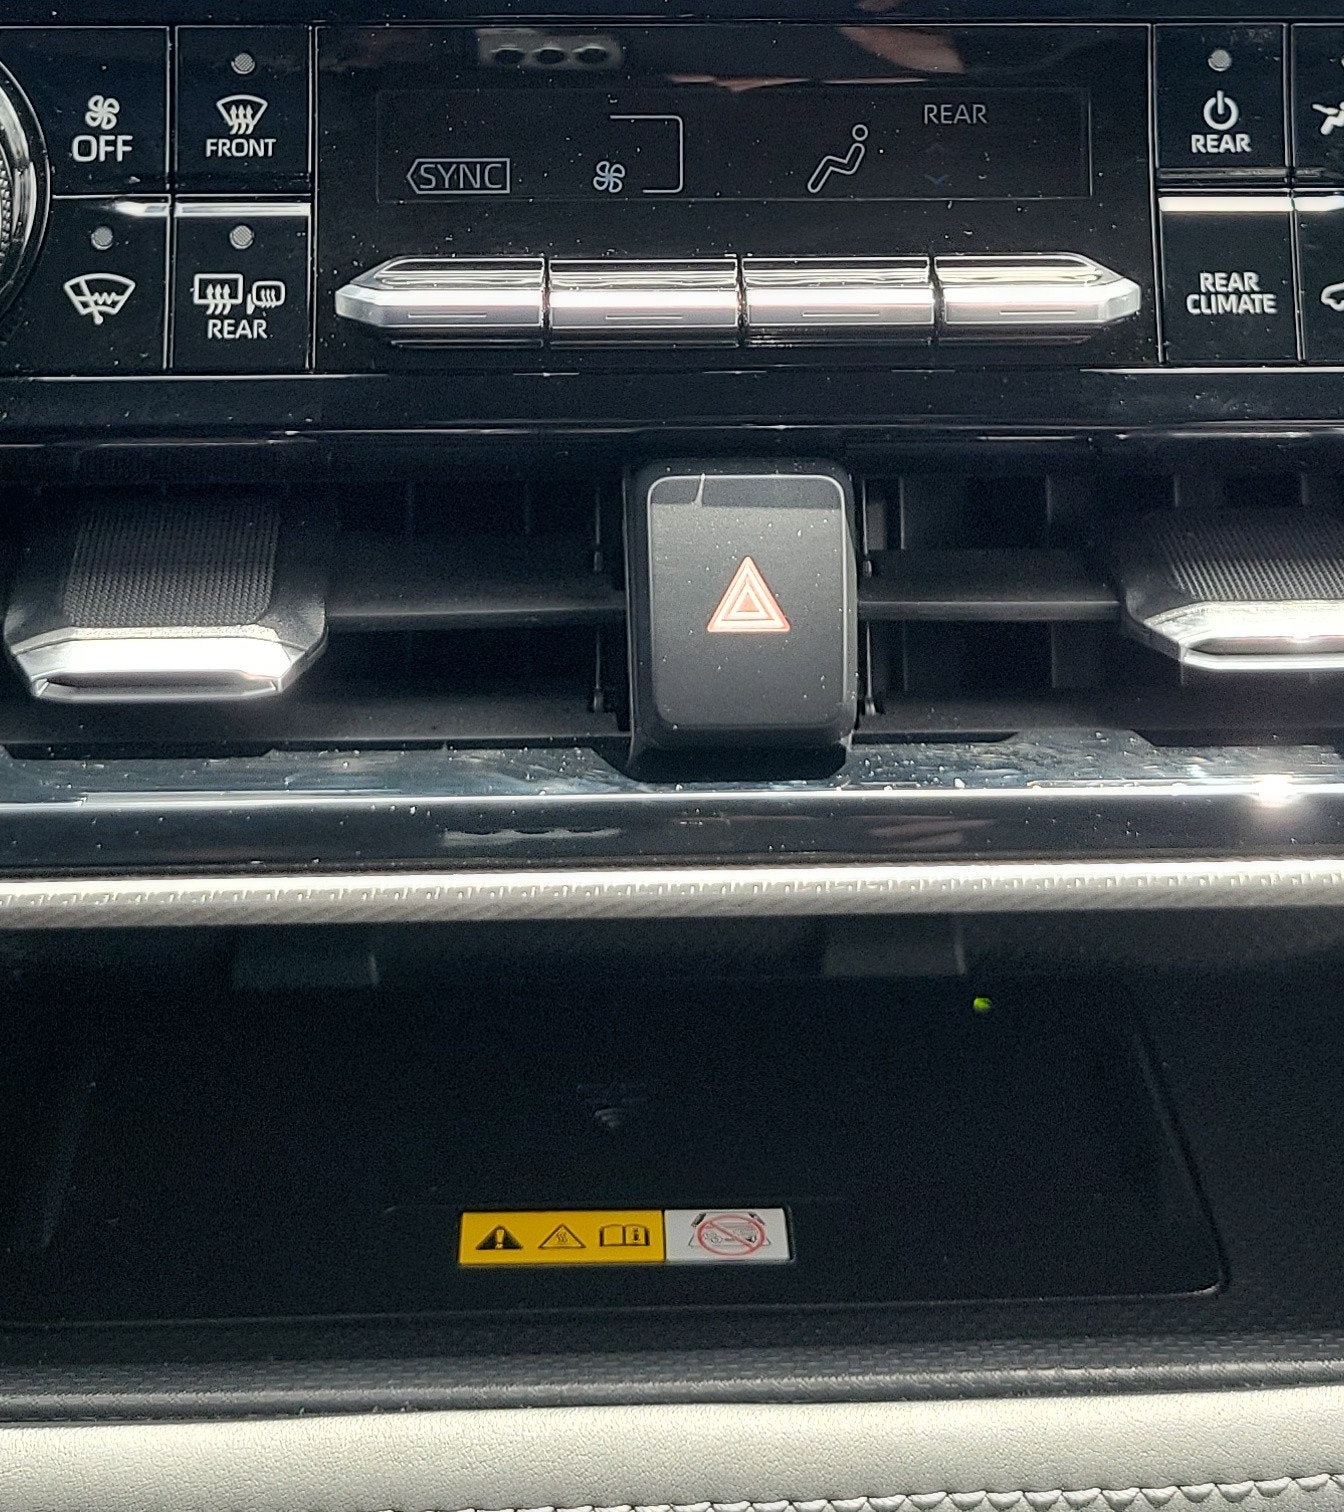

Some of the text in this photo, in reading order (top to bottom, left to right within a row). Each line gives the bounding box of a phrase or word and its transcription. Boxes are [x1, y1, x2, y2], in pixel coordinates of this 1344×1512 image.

[923, 104, 988, 126] REAR
[71, 135, 133, 164] OFF
[205, 138, 277, 158] FRONT
[1190, 133, 1251, 154] REAR
[418, 163, 503, 190] SYNC
[1200, 272, 1260, 292] REAR
[1185, 293, 1277, 315] CLIMATE
[207, 318, 269, 339] REAR
